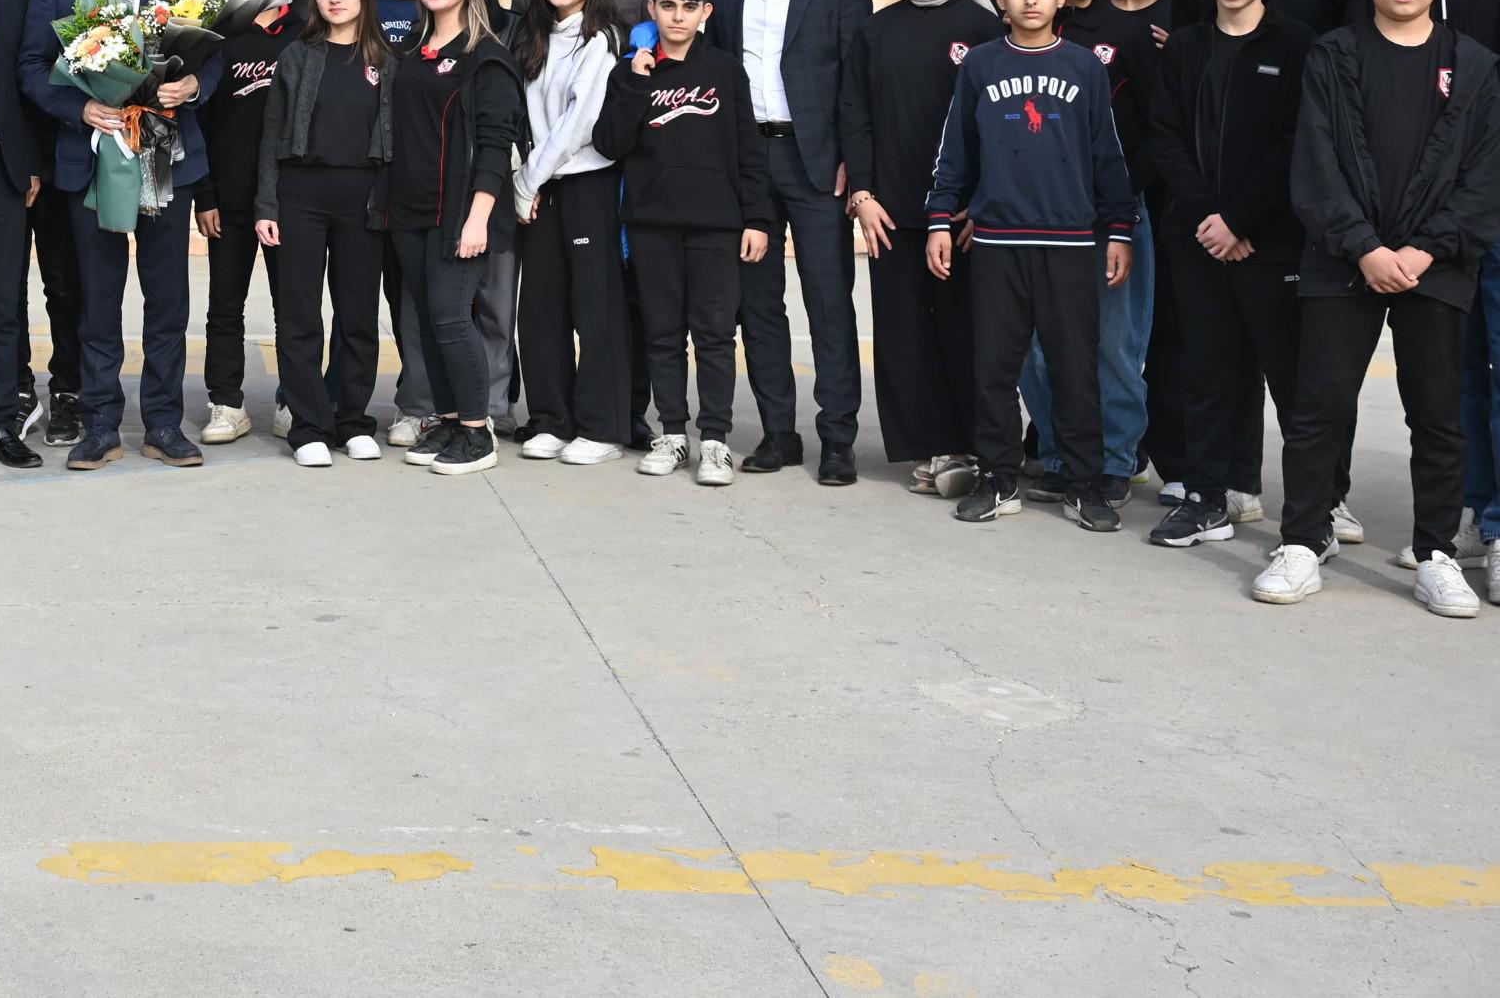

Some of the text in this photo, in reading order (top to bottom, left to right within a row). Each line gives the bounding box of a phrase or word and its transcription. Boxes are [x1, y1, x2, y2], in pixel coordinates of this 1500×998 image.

[231, 60, 278, 82] MÇA
[986, 75, 1080, 103] DODO POLO
